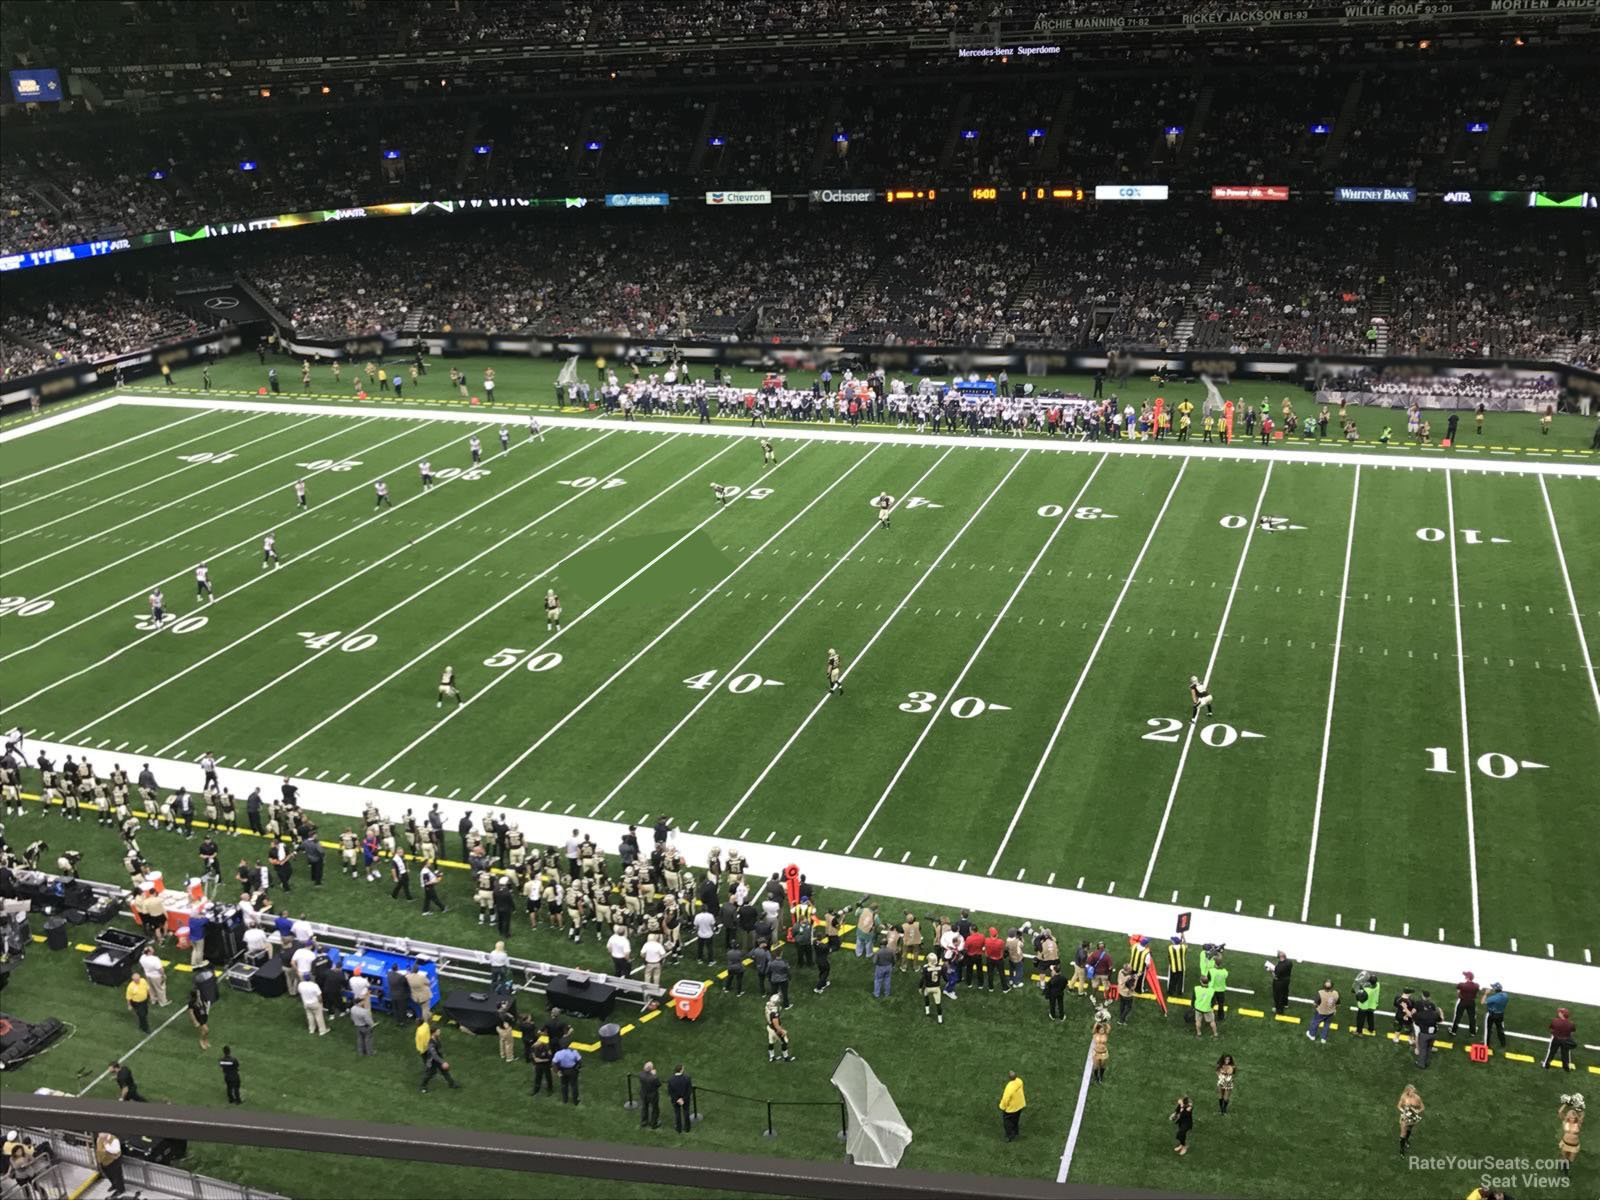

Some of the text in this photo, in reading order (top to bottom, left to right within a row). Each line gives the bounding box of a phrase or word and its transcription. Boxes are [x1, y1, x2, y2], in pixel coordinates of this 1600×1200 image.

[1345, 3, 1454, 17] WILLIE ROAF 93-01
[1490, 0, 1550, 11] MORTEN
[1033, 19, 1073, 31] ARCHIE
[1074, 17, 1125, 29] MANNING
[1182, 10, 1309, 24] RICKEY JACKSON 81-93
[958, 45, 1061, 58] Mercedes-Benz Superdome
[727, 192, 765, 202] Chevron
[822, 189, 870, 202] Ochsner
[929, 190, 935, 200] 0
[972, 189, 996, 199] 15:00
[1037, 188, 1044, 199] 0
[1340, 188, 1410, 200] WHITNEY BANK
[1037, 504, 1103, 520] 30
[1416, 527, 1484, 544] 10
[302, 631, 379, 652] 40
[483, 647, 564, 672] 50
[682, 669, 763, 694] 40
[898, 691, 987, 719] 30
[1141, 717, 1239, 748] 20
[1424, 746, 1519, 779] 10
[1475, 1047, 1486, 1060] 10
